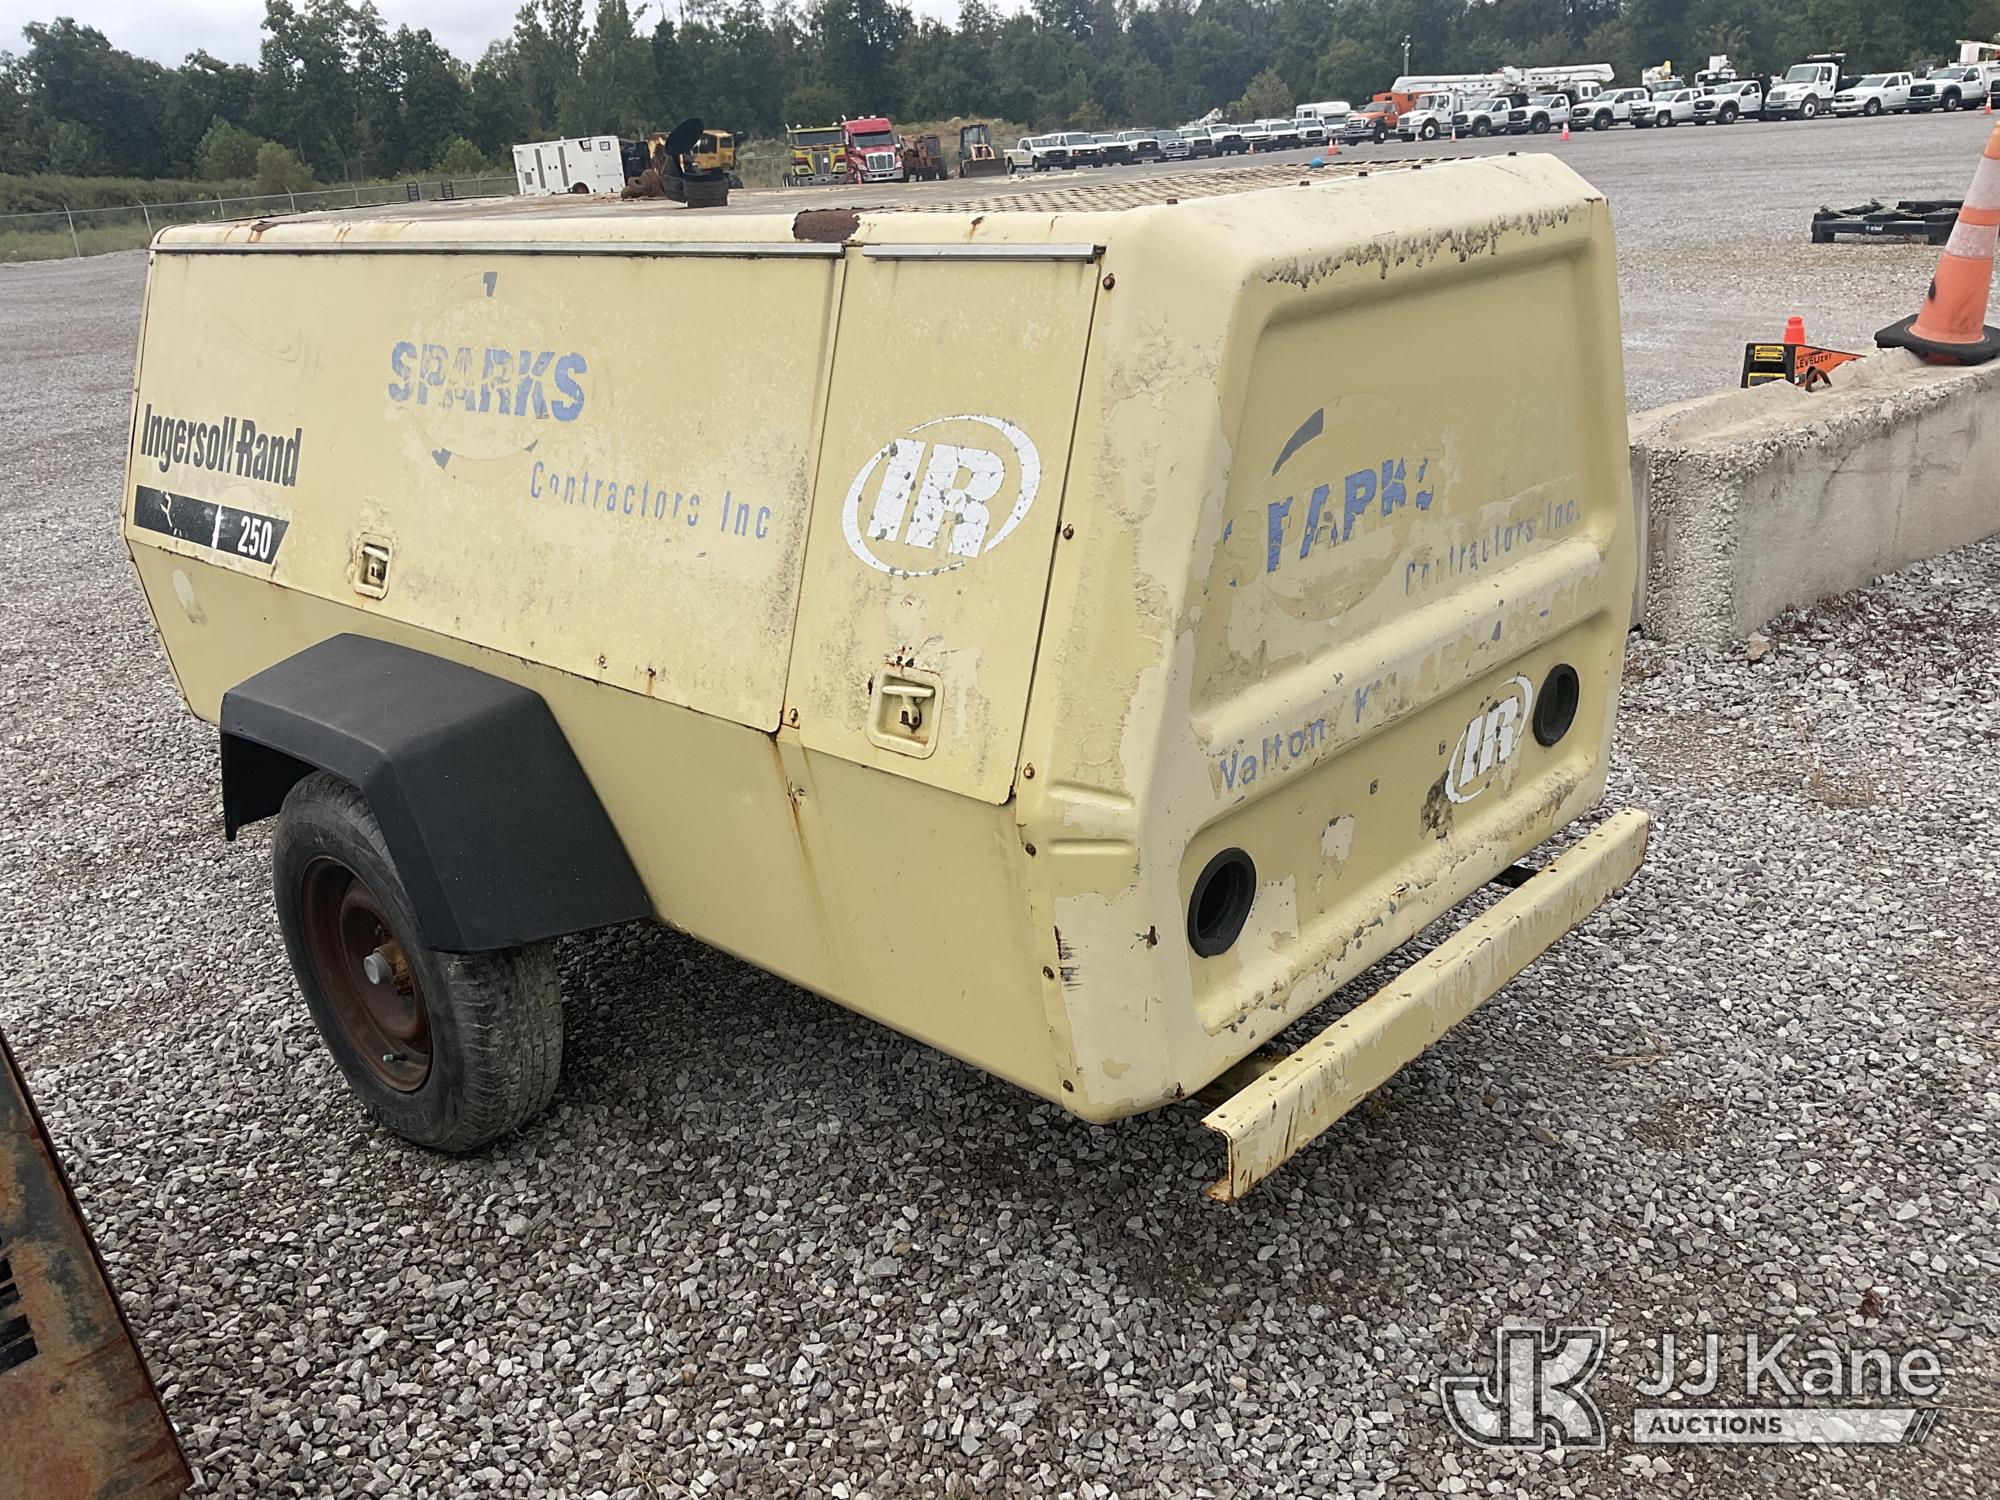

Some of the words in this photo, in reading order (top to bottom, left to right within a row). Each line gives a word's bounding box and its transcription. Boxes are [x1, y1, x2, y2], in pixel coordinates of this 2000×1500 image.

[388, 340, 588, 422] SPARKS
[237, 515, 273, 560] 250
[530, 460, 700, 527] Contractors
[720, 489, 771, 539] Inc
[866, 437, 1006, 558] IR
